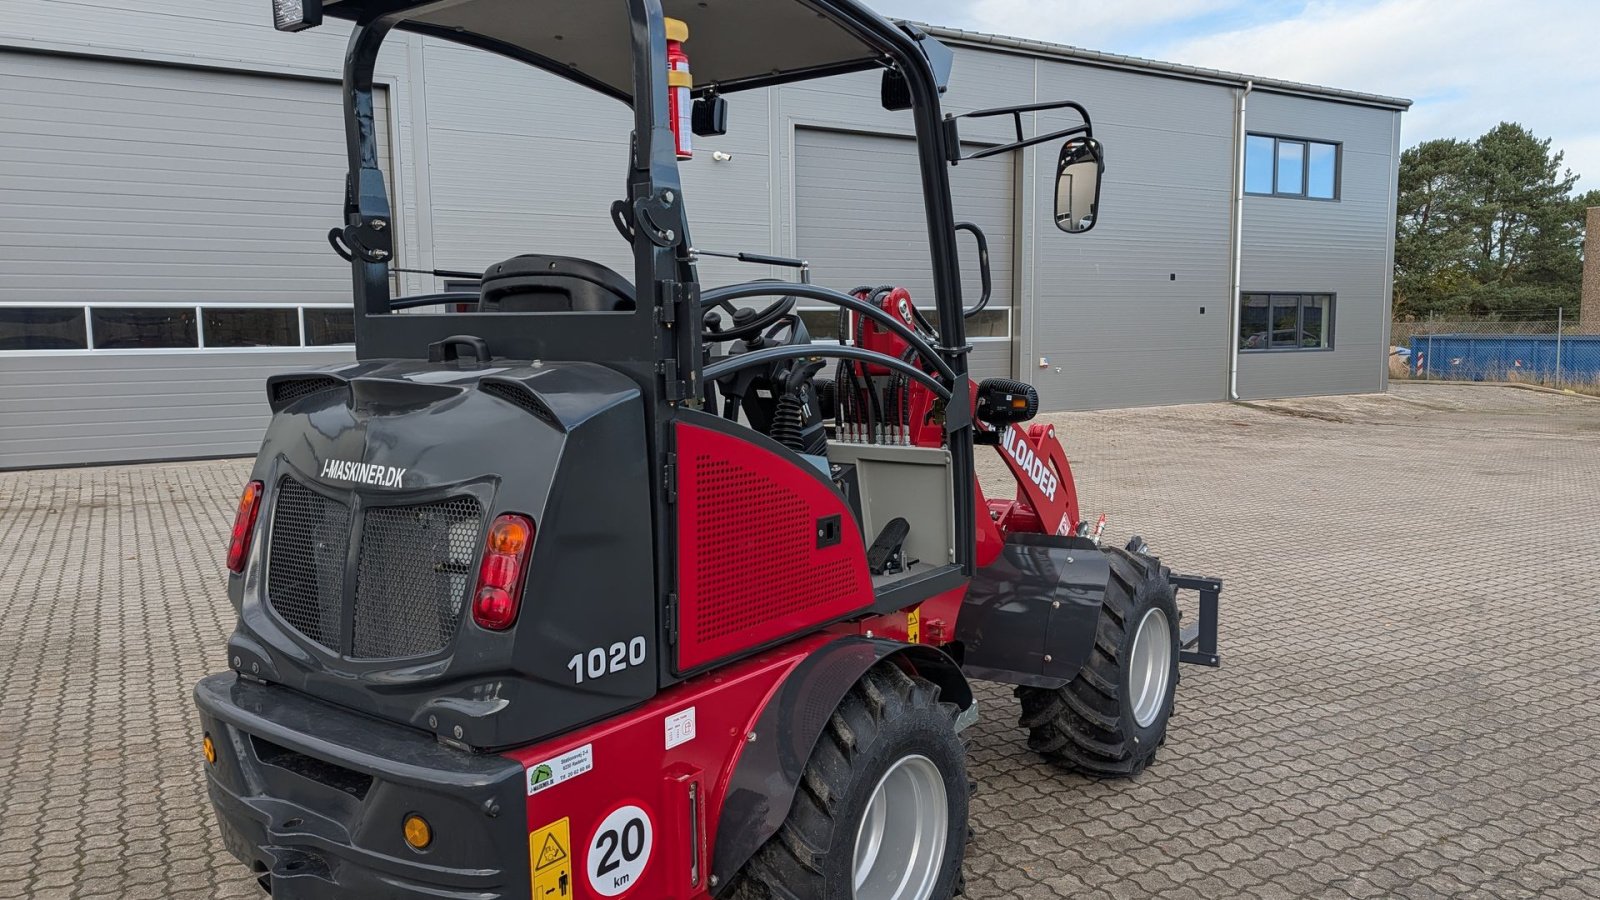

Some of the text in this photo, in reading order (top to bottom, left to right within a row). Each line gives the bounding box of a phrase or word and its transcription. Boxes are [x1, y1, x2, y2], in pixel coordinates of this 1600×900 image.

[320, 458, 407, 489] J-MASKINER.DK
[567, 635, 646, 684] 1020
[595, 817, 645, 878] 20
[613, 873, 630, 889] km
